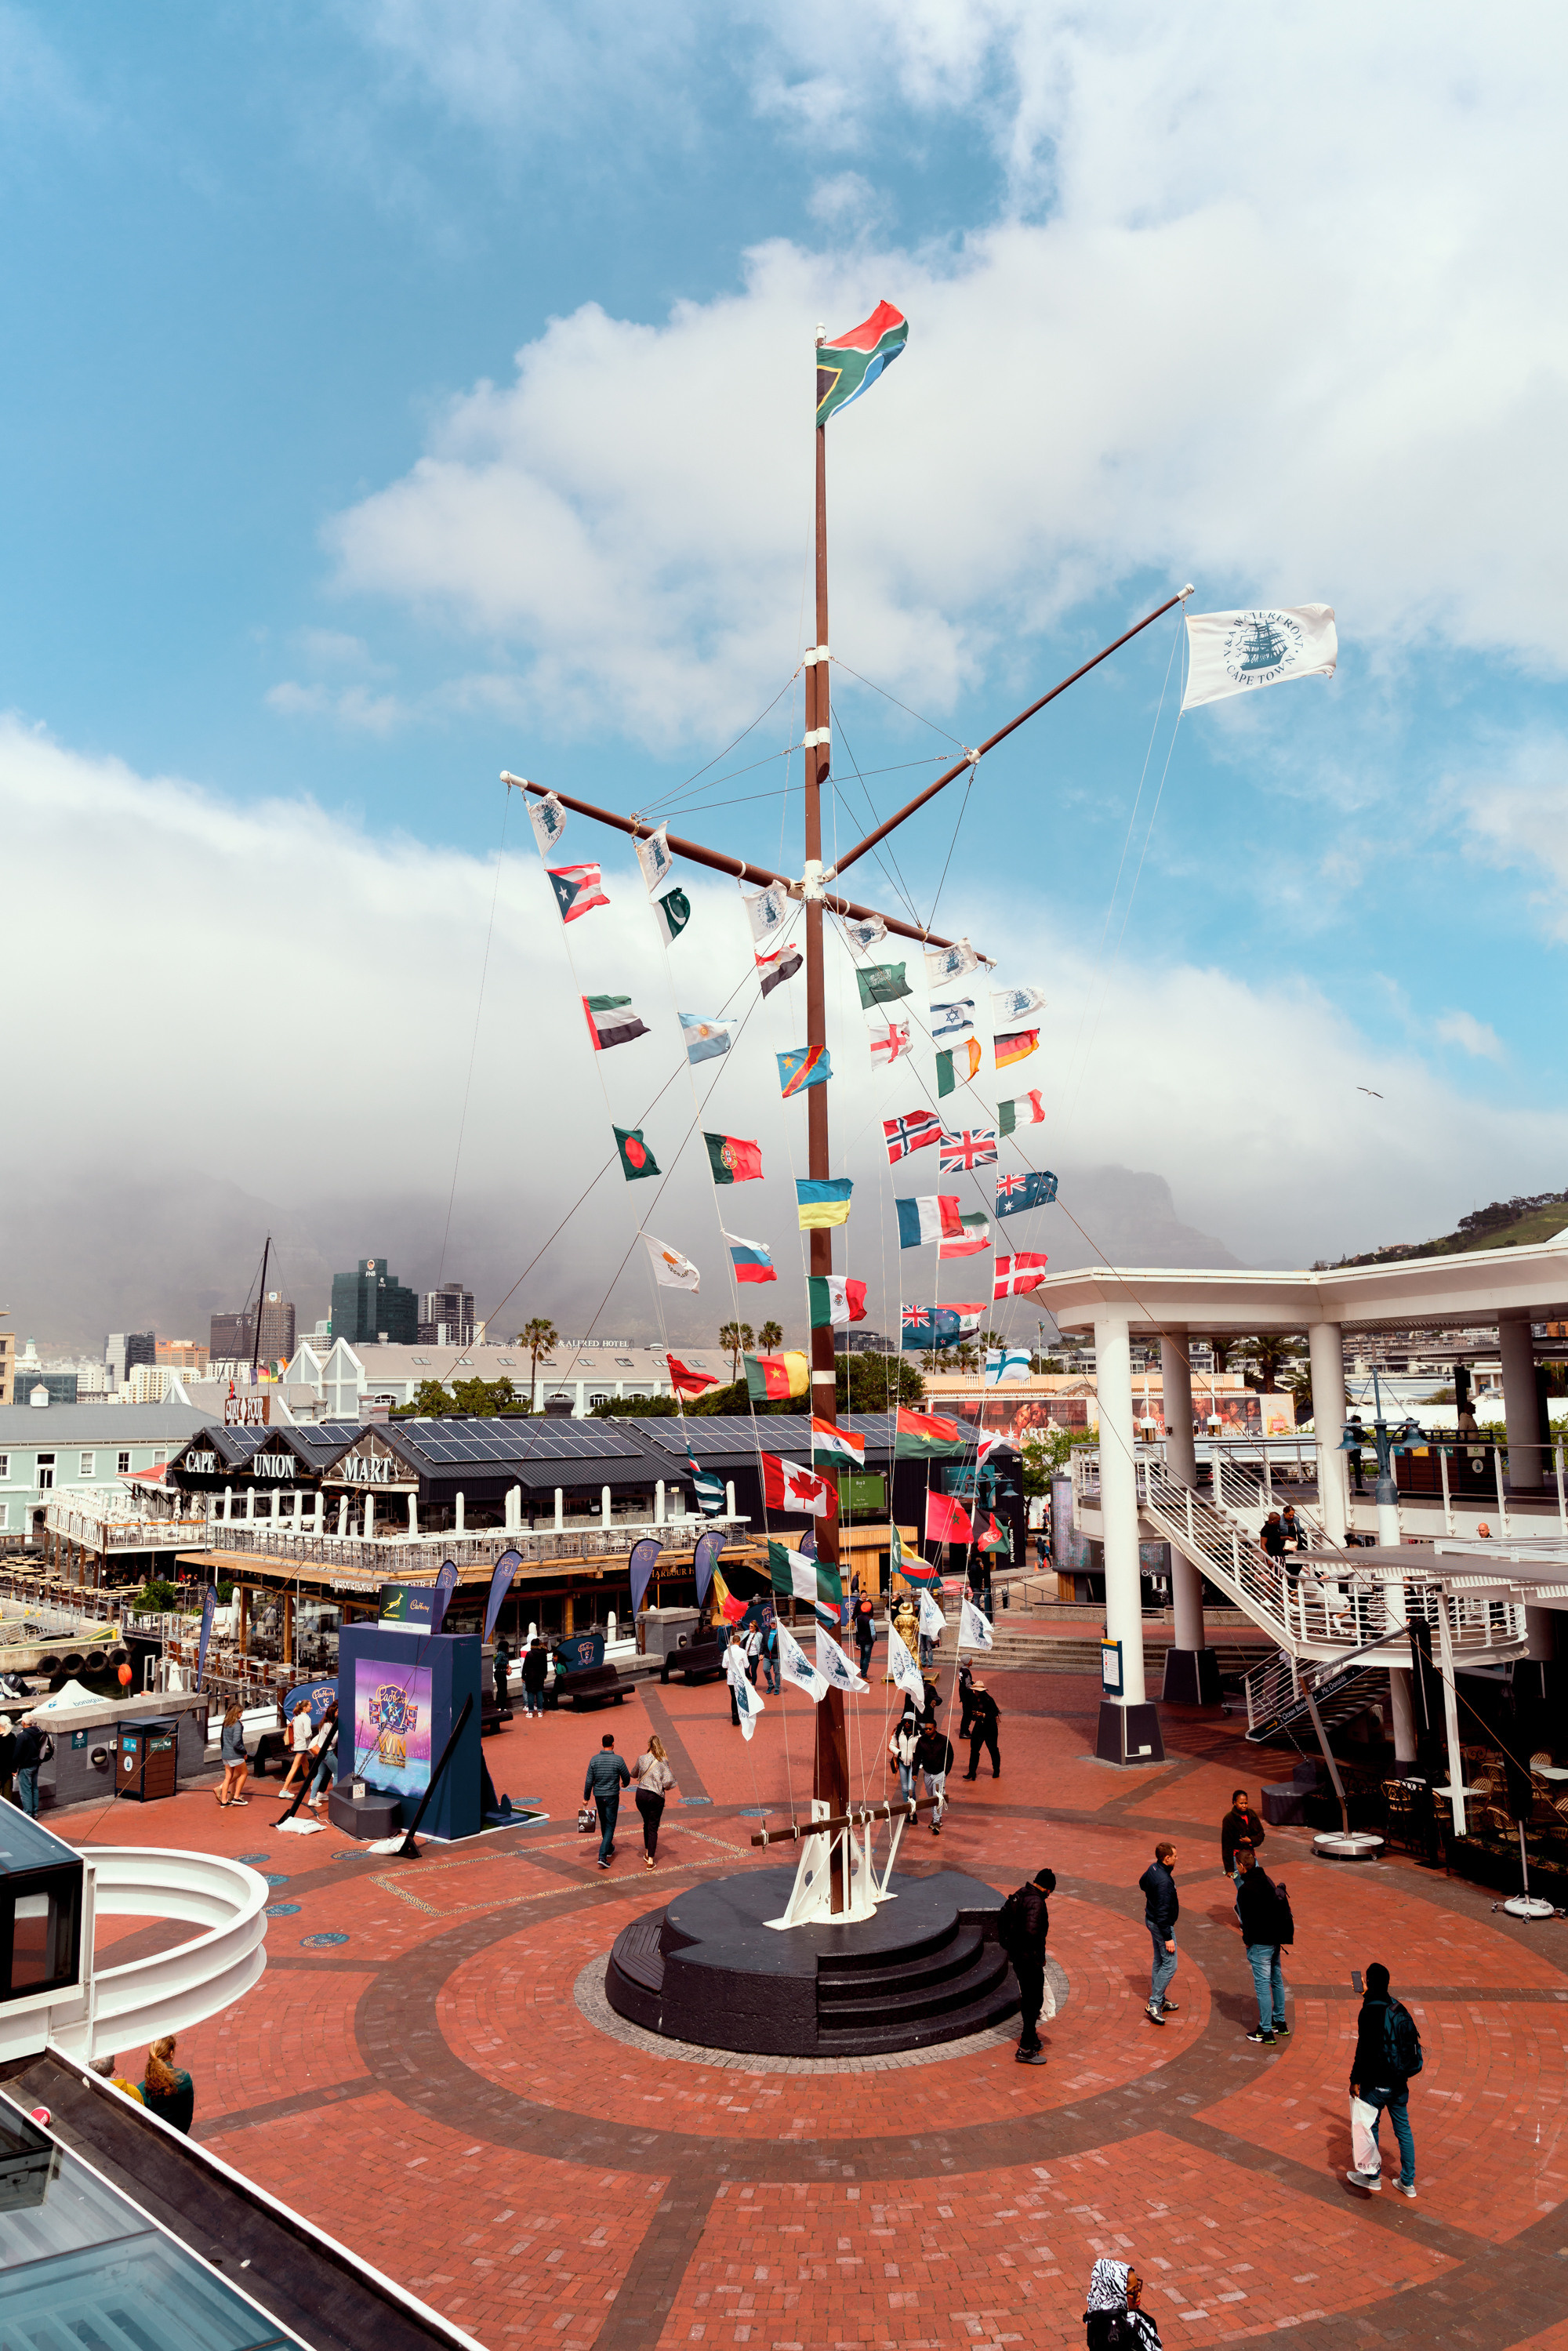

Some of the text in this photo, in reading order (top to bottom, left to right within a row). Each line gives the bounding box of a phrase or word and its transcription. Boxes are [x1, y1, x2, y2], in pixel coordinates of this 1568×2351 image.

[1233, 611, 1304, 648] WATERFRONT
[1226, 655, 1296, 686] CAPE TOWN
[226, 1397, 263, 1420] QUAY FOUR
[186, 1452, 217, 1473] CAPE
[253, 1454, 296, 1478] UNION
[343, 1457, 392, 1483] MART
[410, 1599, 430, 1613] Cadbury
[827, 1666, 842, 1683] CAPE
[1329, 1676, 1347, 1690] Donalds
[73, 1696, 104, 1707] bonaqua
[376, 1685, 409, 1704] Cadbury
[1282, 1701, 1308, 1720] Ocean Baske
[379, 1736, 406, 1758] WIN
